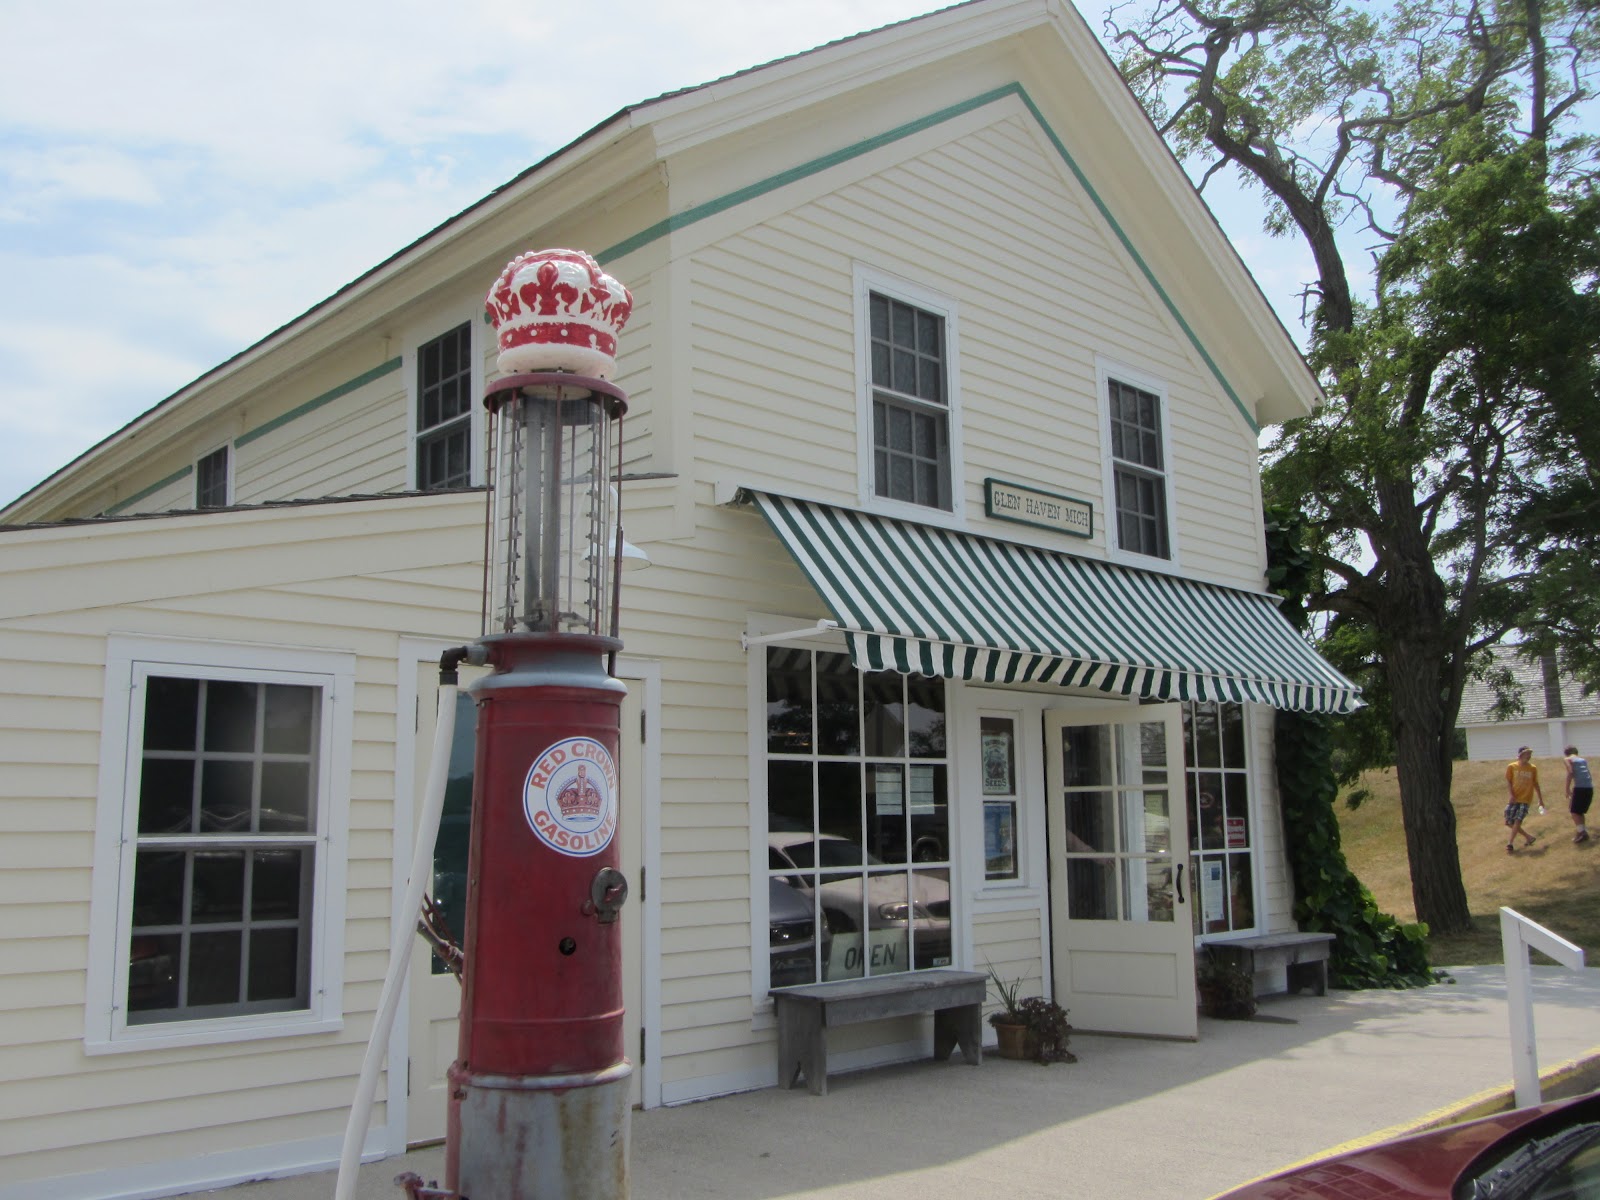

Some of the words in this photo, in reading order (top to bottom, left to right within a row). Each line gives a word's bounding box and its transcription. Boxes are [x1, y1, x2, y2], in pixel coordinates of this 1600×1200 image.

[994, 491, 1021, 511] GLEN
[1026, 498, 1061, 520] HAVEN
[1065, 508, 1088, 527] MICH
[530, 749, 567, 789] RED
[571, 743, 615, 789] CROWN
[534, 810, 614, 850] GASOLINE
